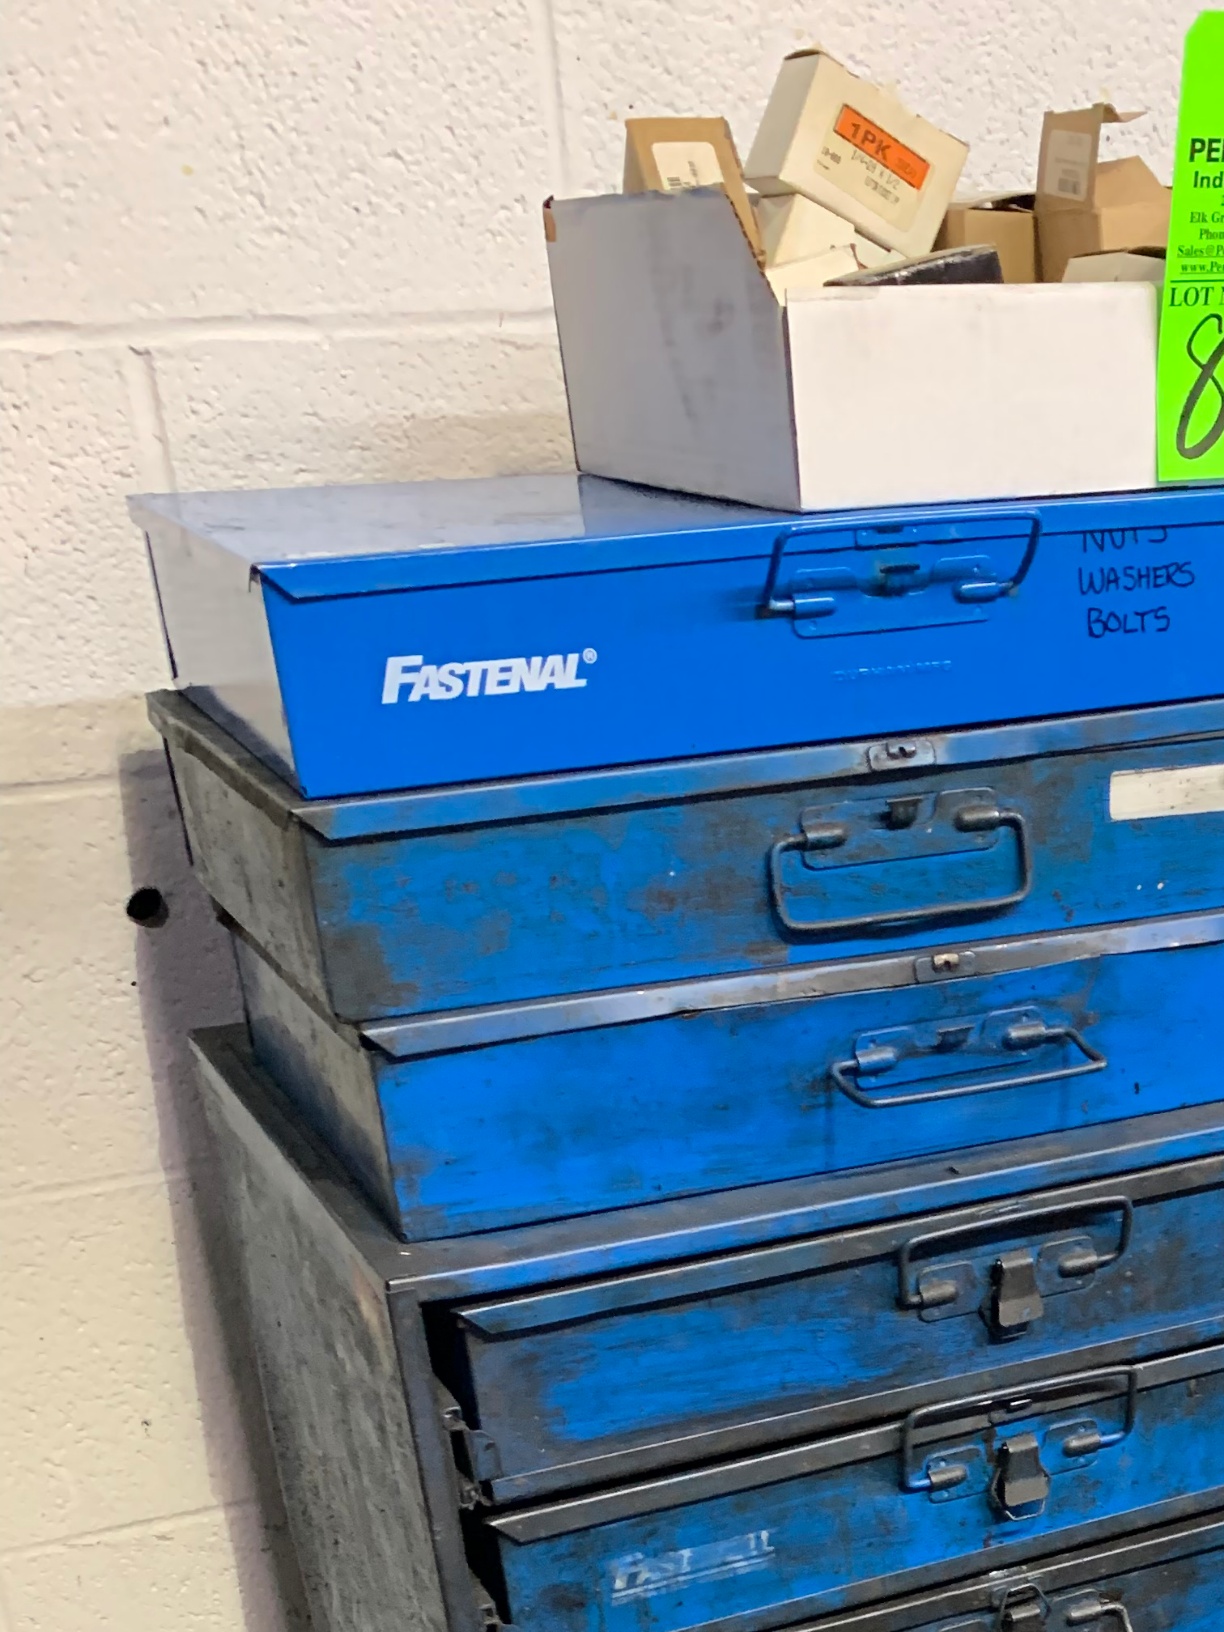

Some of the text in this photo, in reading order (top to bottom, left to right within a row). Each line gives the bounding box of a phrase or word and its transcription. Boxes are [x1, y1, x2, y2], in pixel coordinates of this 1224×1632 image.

[1189, 211, 1208, 223] Elk
[1168, 286, 1214, 307] LOT
[1077, 560, 1196, 596] WASHERS
[1086, 605, 1172, 639] BOLTS
